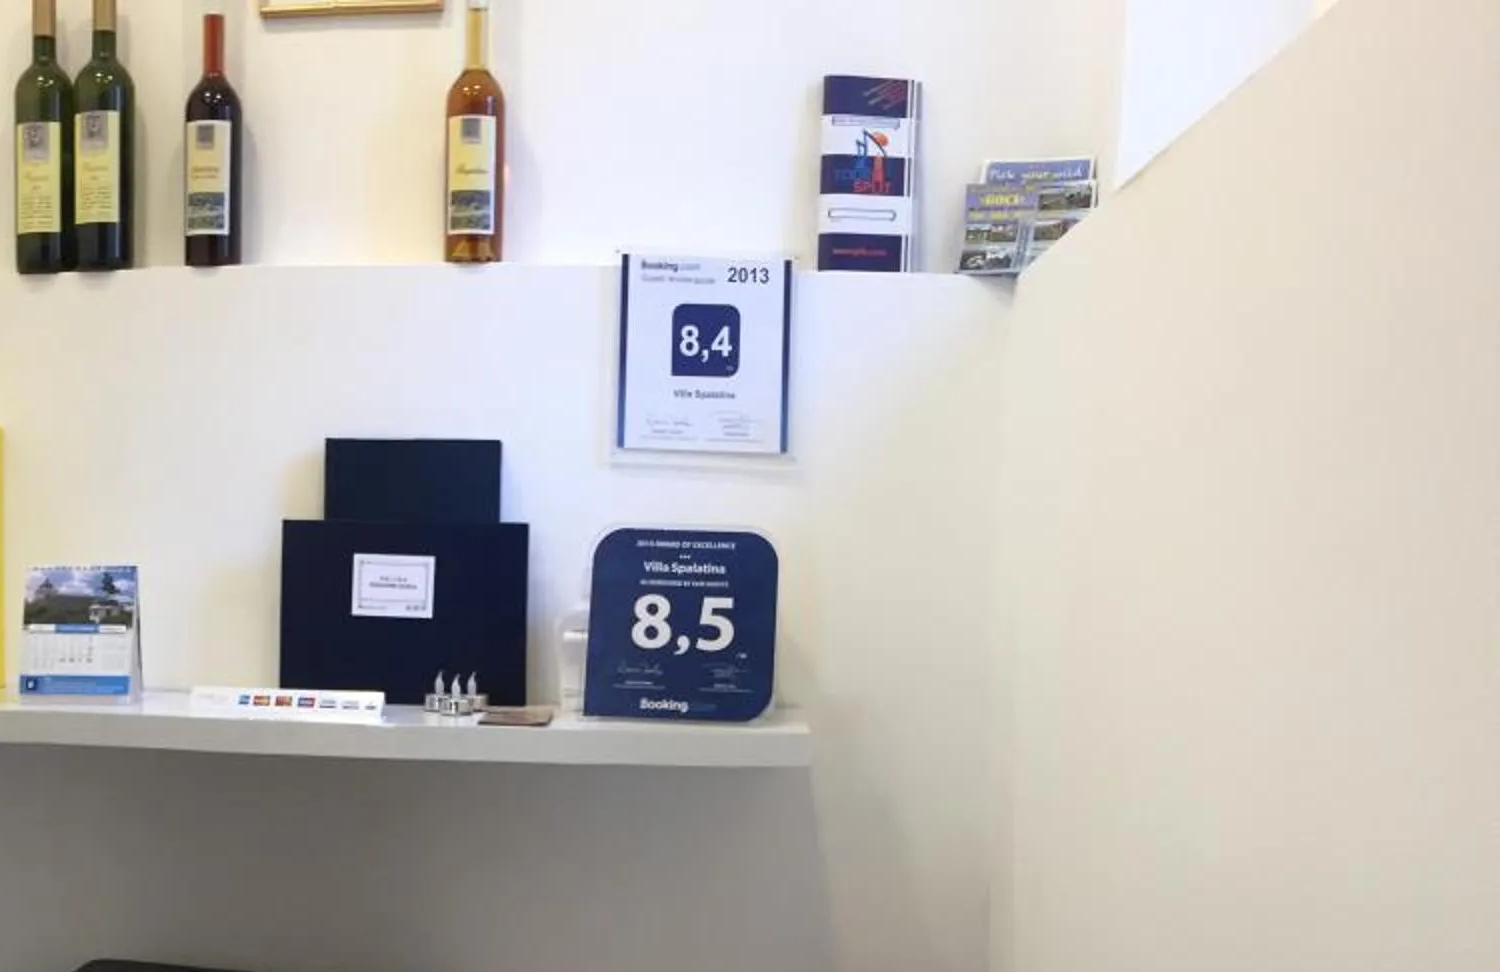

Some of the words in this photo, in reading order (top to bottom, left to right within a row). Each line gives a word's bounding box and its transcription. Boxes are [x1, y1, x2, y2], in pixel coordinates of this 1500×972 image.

[727, 267, 770, 284] 2013
[679, 324, 733, 363] 8,4
[643, 560, 669, 573] Villa
[671, 561, 725, 575] Spalatina
[630, 593, 736, 656] 8,5
